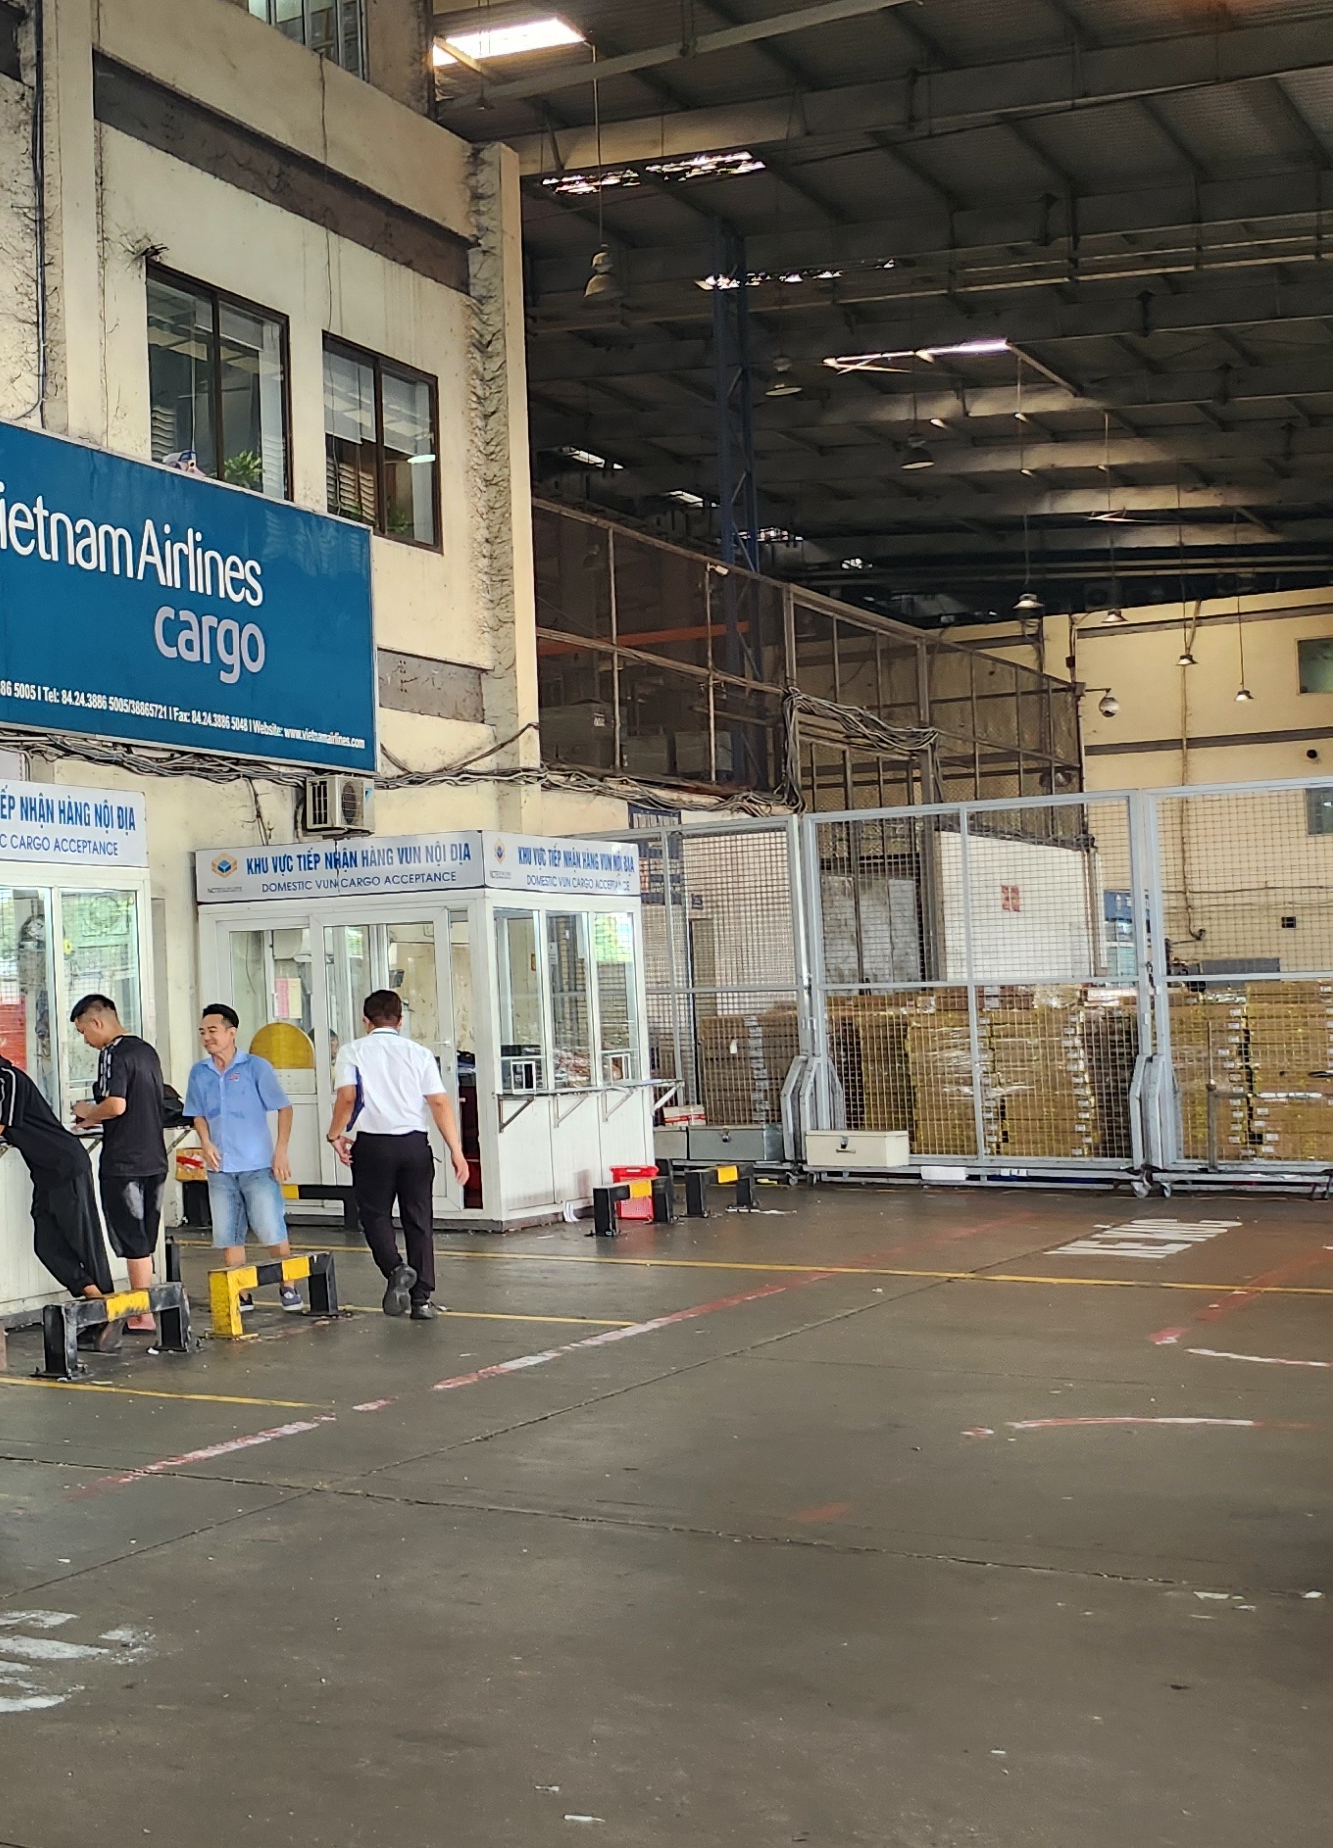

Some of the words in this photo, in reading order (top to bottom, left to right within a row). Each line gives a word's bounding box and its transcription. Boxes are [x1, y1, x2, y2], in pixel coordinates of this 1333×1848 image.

[154, 606, 265, 684] cargo
[13, 682, 37, 700] 5005
[43, 686, 60, 703] Tel:
[173, 707, 191, 723] Fax:
[20, 792, 55, 828] NHẬN
[58, 795, 90, 827] HÀNG
[94, 799, 114, 835] NỘI
[117, 807, 136, 835] ĐỊA
[10, 835, 51, 851] CARGO
[53, 837, 118, 856] ACCEPTANCE
[246, 857, 269, 875] KHU
[271, 854, 294, 877] VỰC
[297, 847, 320, 872] TIẾP
[324, 848, 358, 873] NHẬN
[361, 845, 393, 868] HÀNG
[397, 847, 422, 866] VUN
[426, 840, 447, 867] NỘI
[450, 842, 472, 866] ĐỊA
[518, 846, 532, 866] KHU
[261, 879, 313, 893] DOMESTIC
[315, 878, 338, 890] VUN
[340, 876, 381, 888] CARGO
[384, 871, 457, 885] ACCEPTANCE
[526, 874, 558, 887] DOMESTIC
